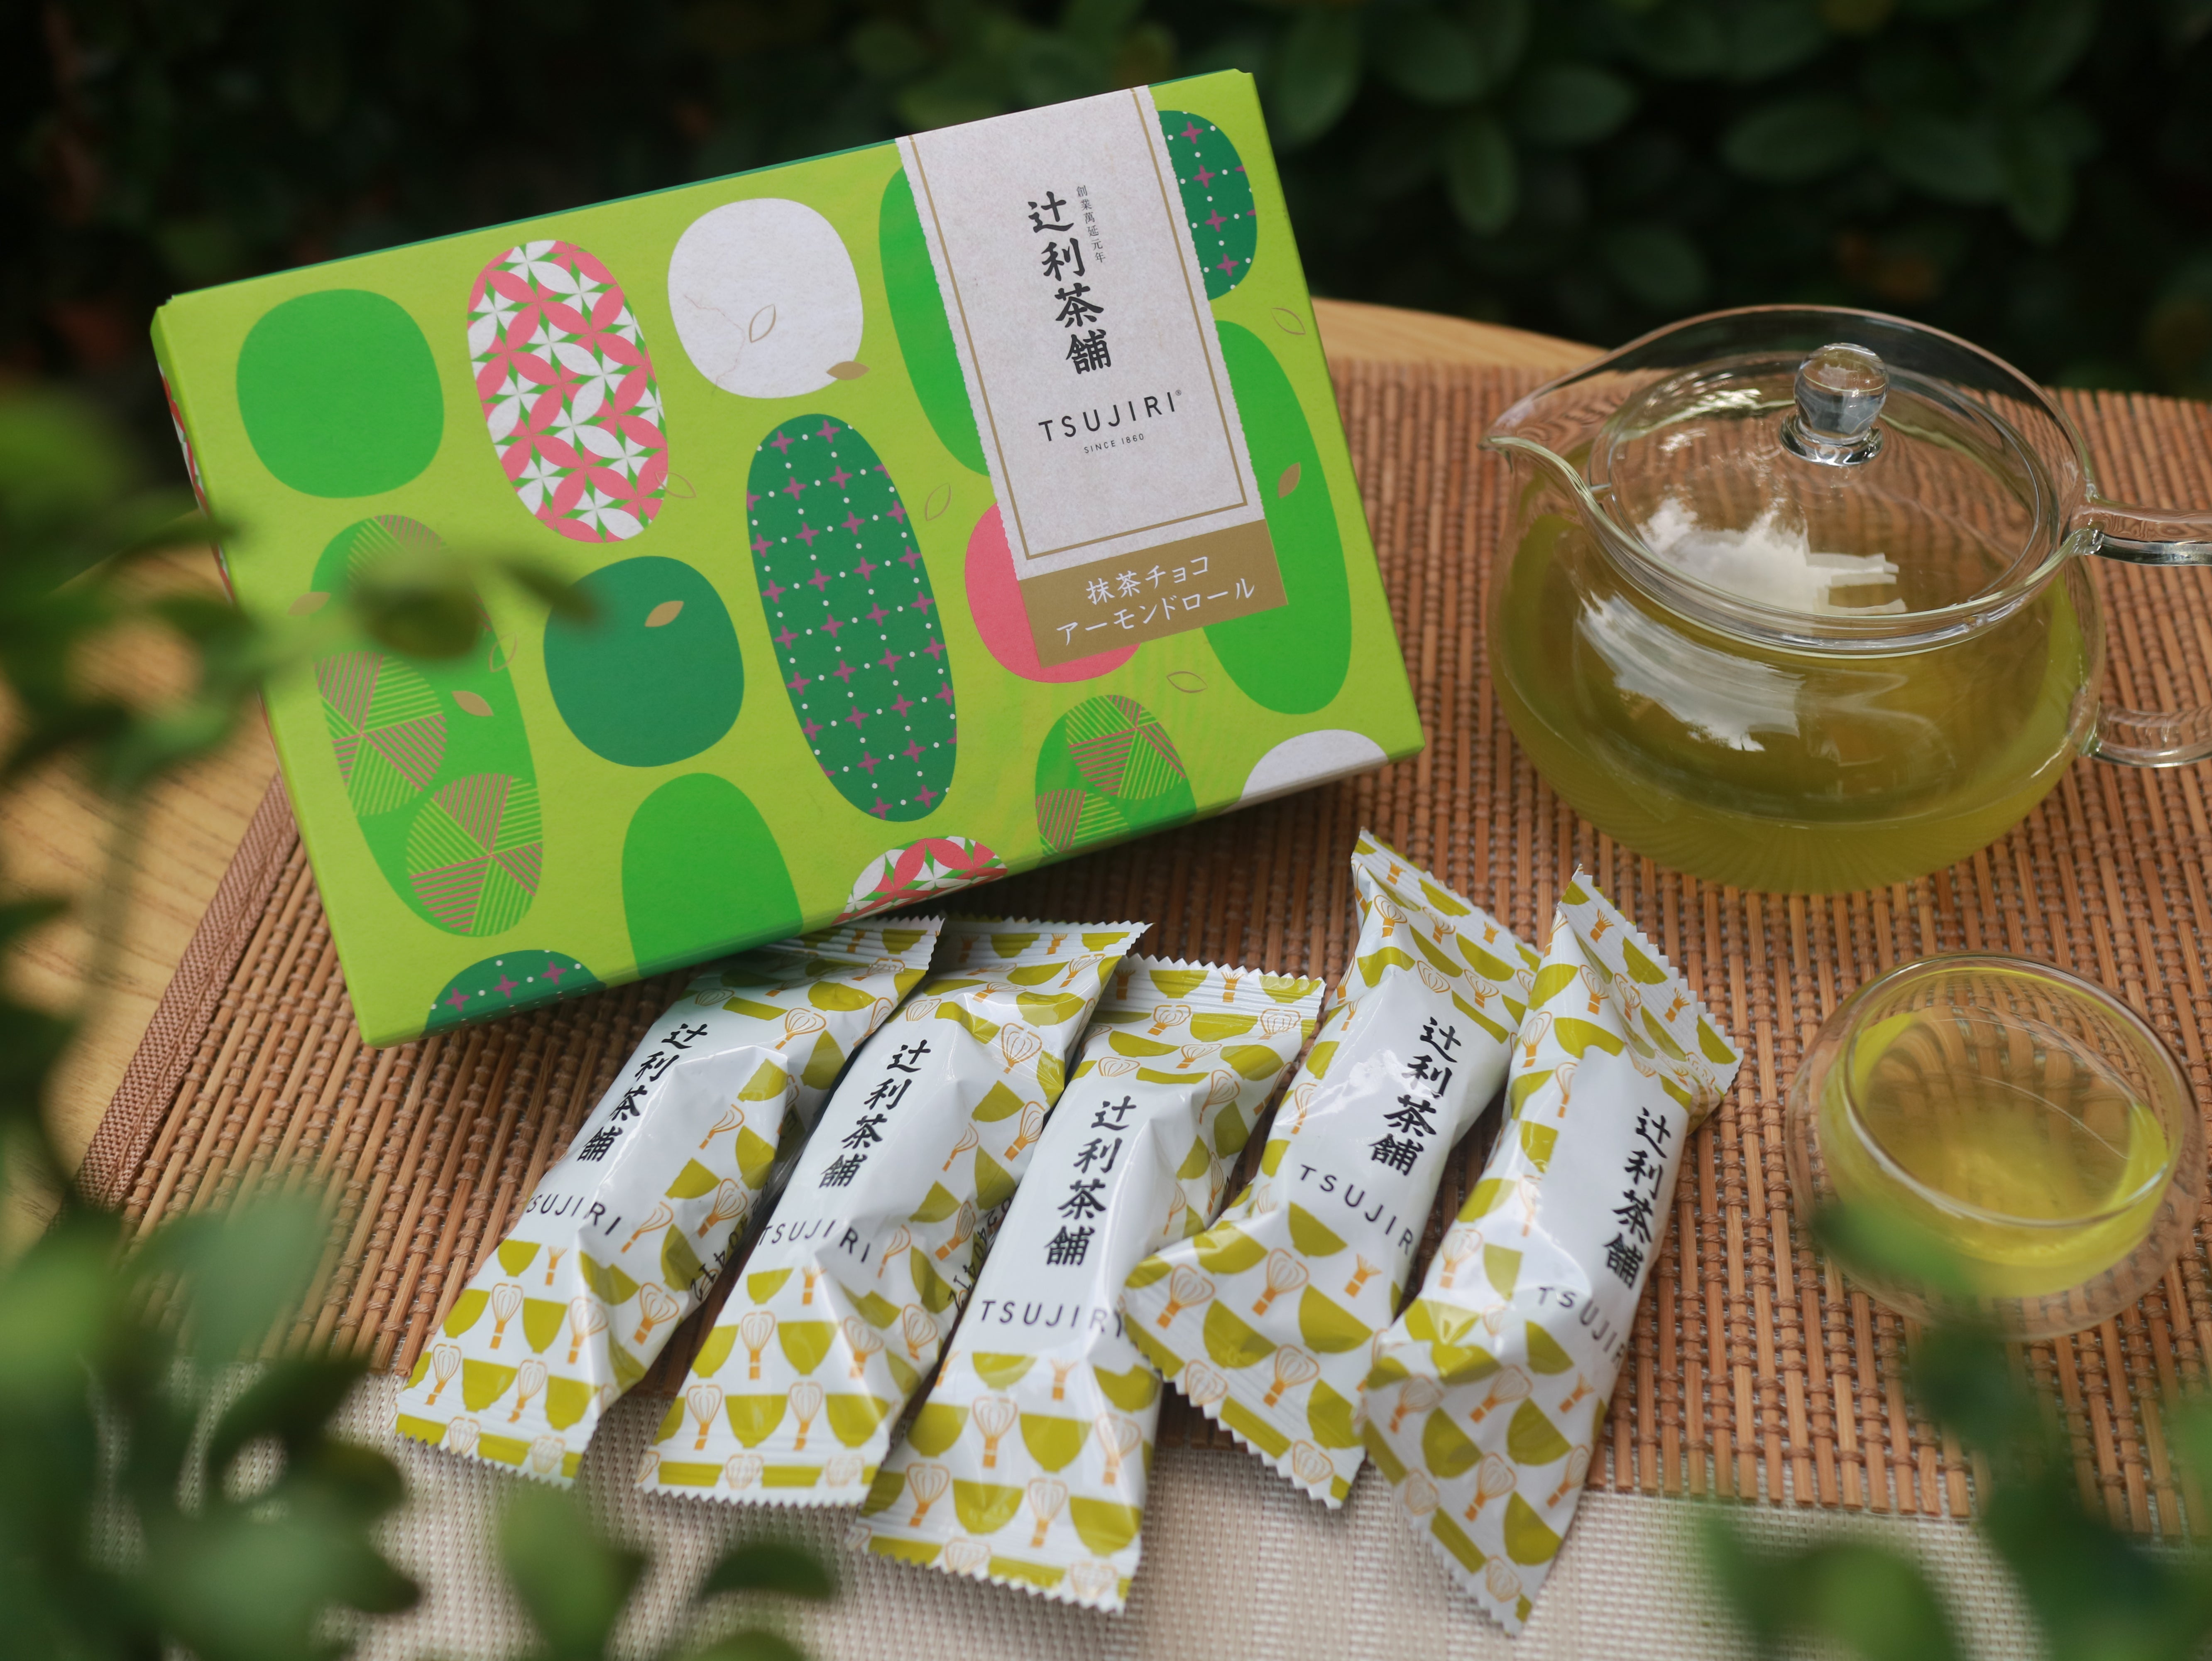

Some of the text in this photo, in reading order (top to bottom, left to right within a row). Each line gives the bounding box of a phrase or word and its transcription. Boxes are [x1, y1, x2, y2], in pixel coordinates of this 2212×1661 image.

[1076, 185, 1105, 263] 創業萬延元年
[1028, 191, 1111, 374] 辻利茶舗
[1084, 433, 1144, 453] SINCE 1860
[1056, 578, 1255, 646] アーモンドロール
[1085, 556, 1209, 605] 抹茶チョコ
[577, 1023, 708, 1162] 辻利茶舗
[818, 1039, 931, 1188] 辻利茶舗
[1368, 1017, 1462, 1176] 辻利茶舗
[526, 1193, 622, 1236] SUJIRI
[1044, 1095, 1137, 1266] 辻利茶舗
[1602, 1106, 1671, 1290] 辻利茶舗
[759, 1218, 871, 1263] TSUJIRI
